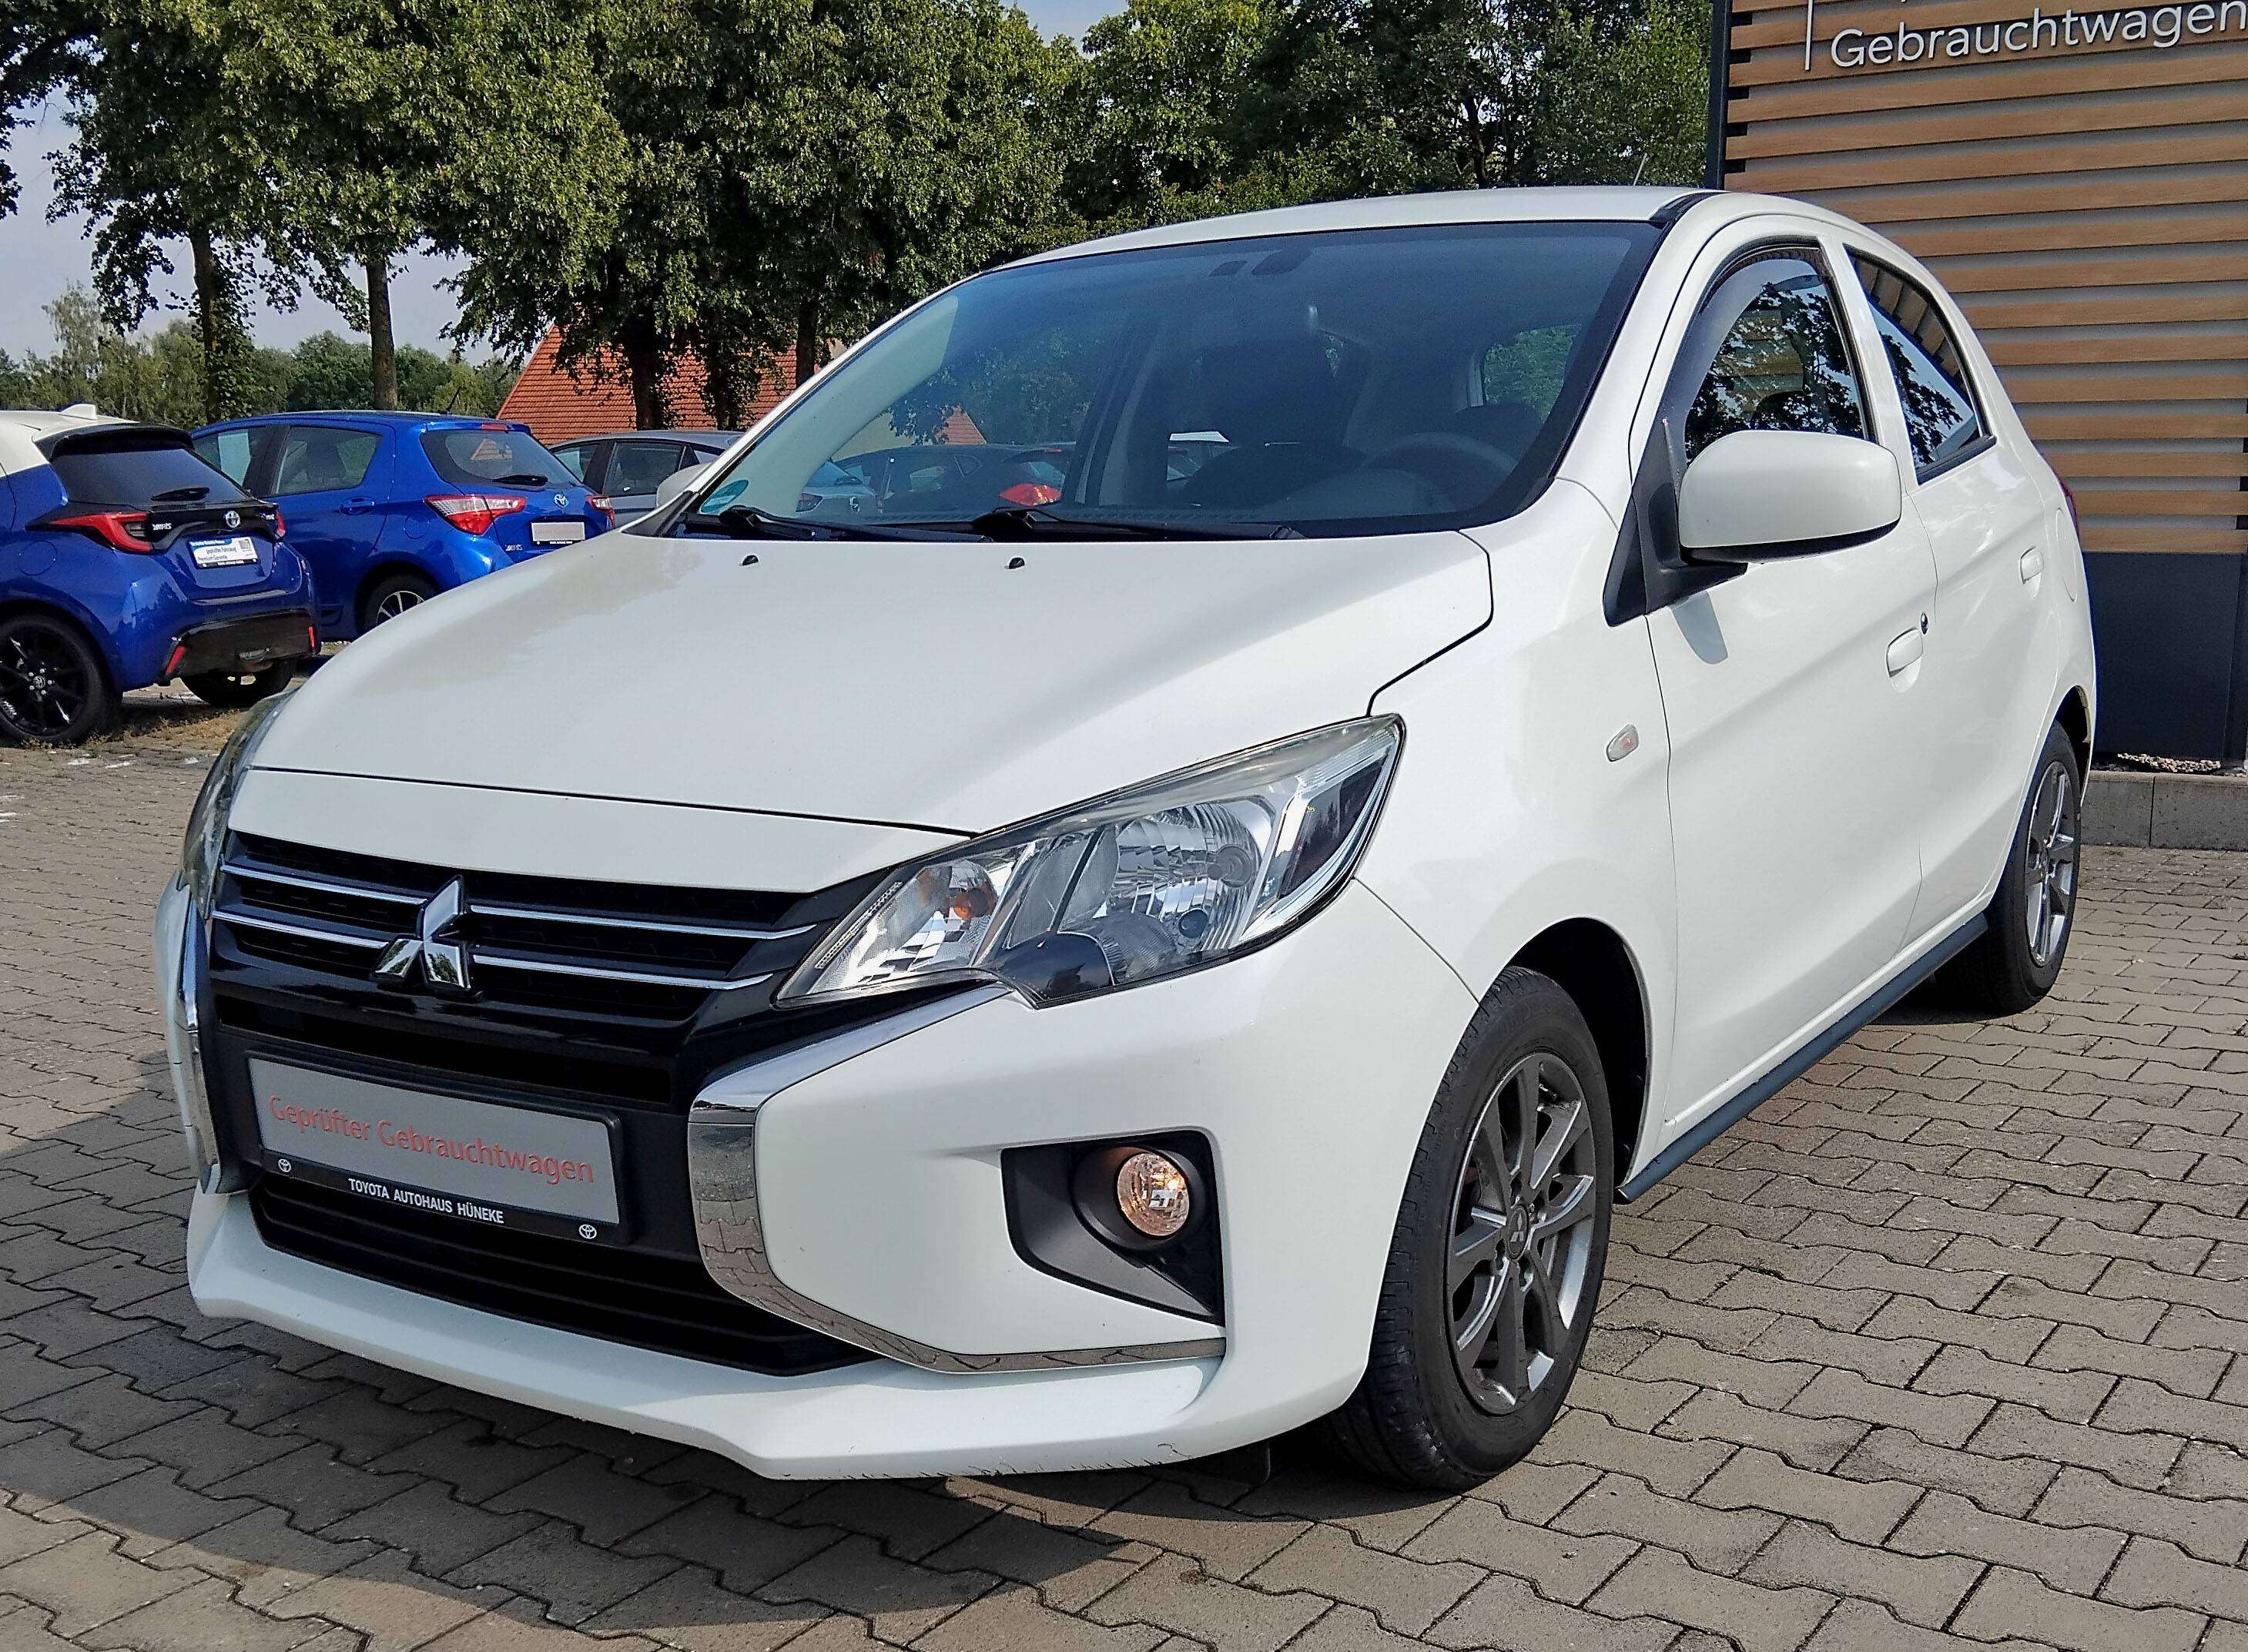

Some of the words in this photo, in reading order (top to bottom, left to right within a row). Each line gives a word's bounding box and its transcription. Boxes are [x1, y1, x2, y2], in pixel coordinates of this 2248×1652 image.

[1831, 0, 2248, 67] Gebrauchtwagen
[269, 1095, 370, 1141] Geprüfter
[377, 1121, 594, 1184] Gebrauchtwagen
[348, 1178, 390, 1199] TOYOTA
[394, 1191, 453, 1214] AUTOHAUS
[457, 1201, 504, 1224] HÜNEKE
